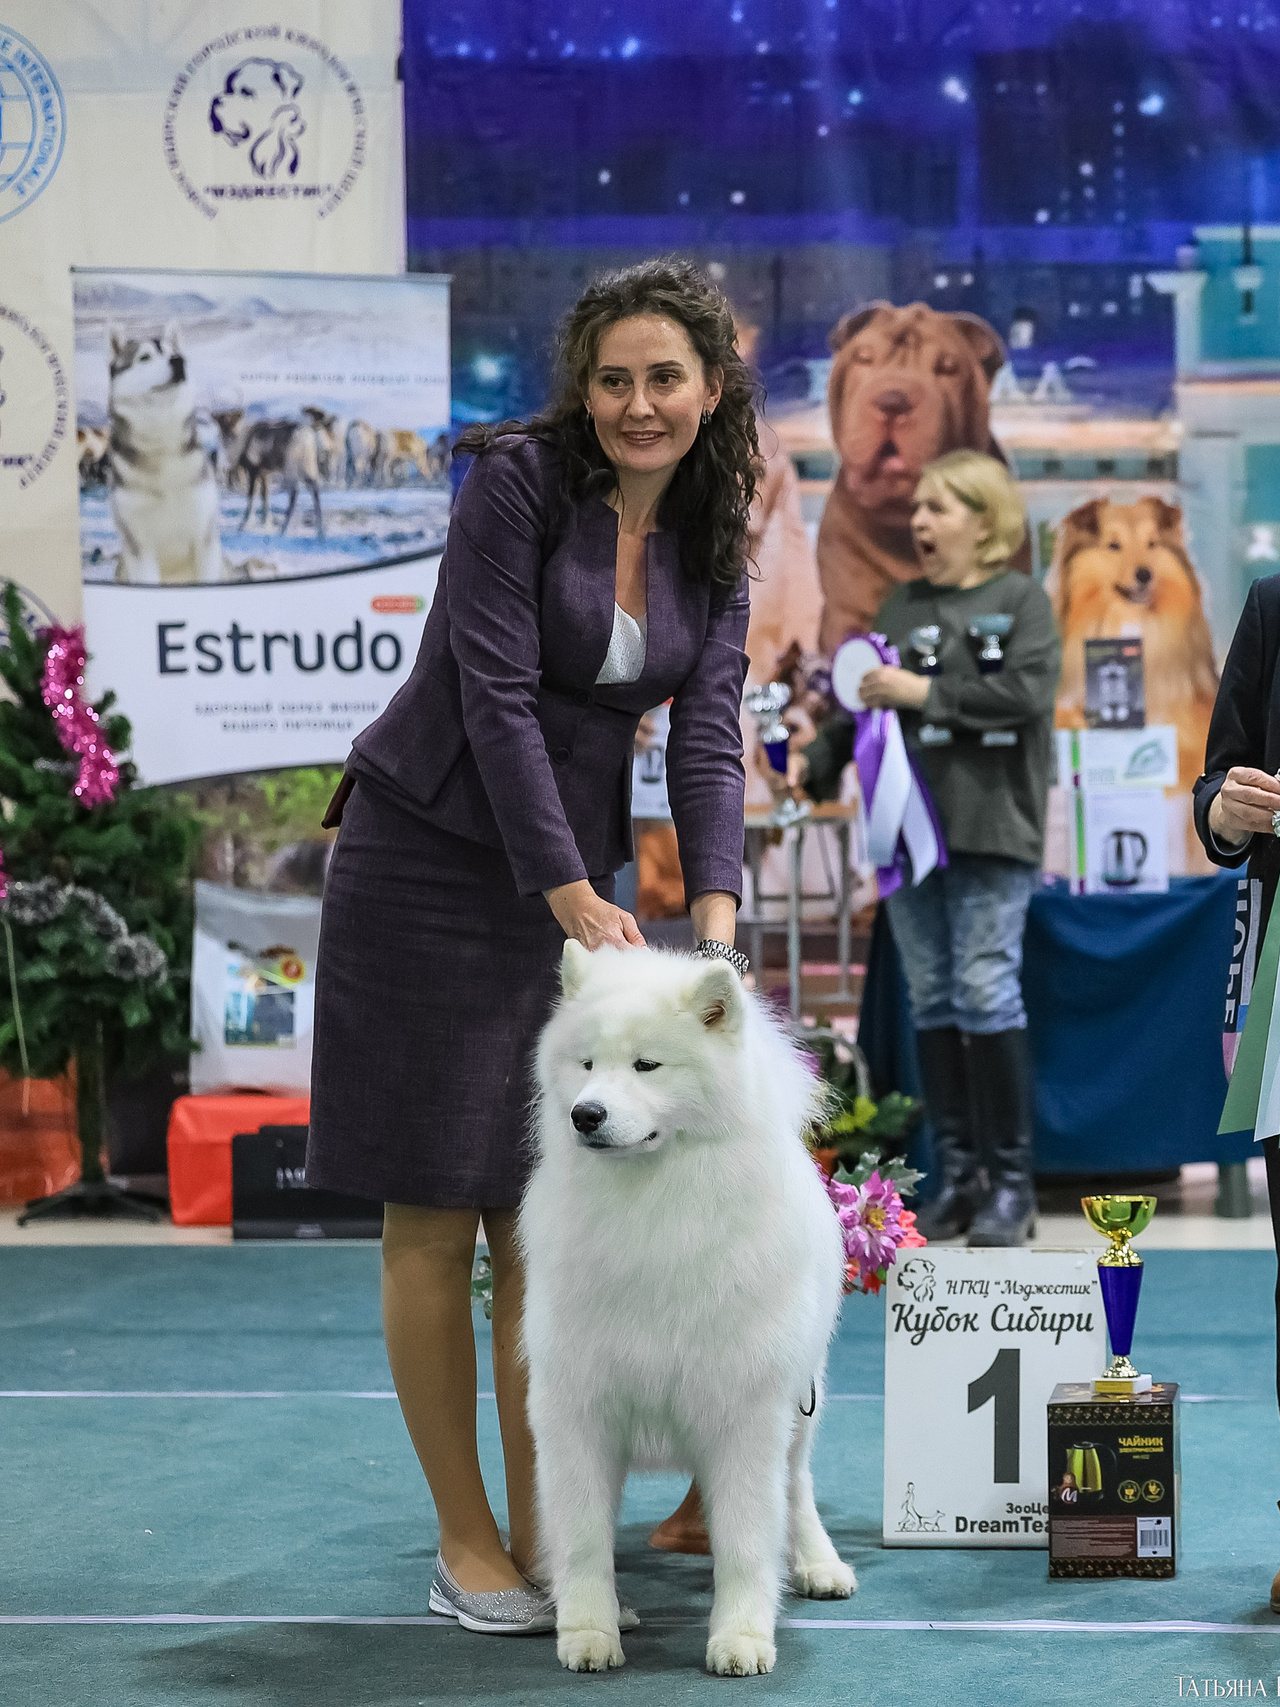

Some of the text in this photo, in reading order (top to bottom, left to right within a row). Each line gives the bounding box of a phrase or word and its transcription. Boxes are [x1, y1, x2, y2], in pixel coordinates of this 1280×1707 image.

[157, 618, 402, 676] Estrudo
[946, 1280, 990, 1298] НГКЦ
[891, 1303, 1094, 1346] Кубок Сибири
[967, 1348, 1020, 1484] 1
[1118, 1436, 1164, 1447] ЧАЙНИК
